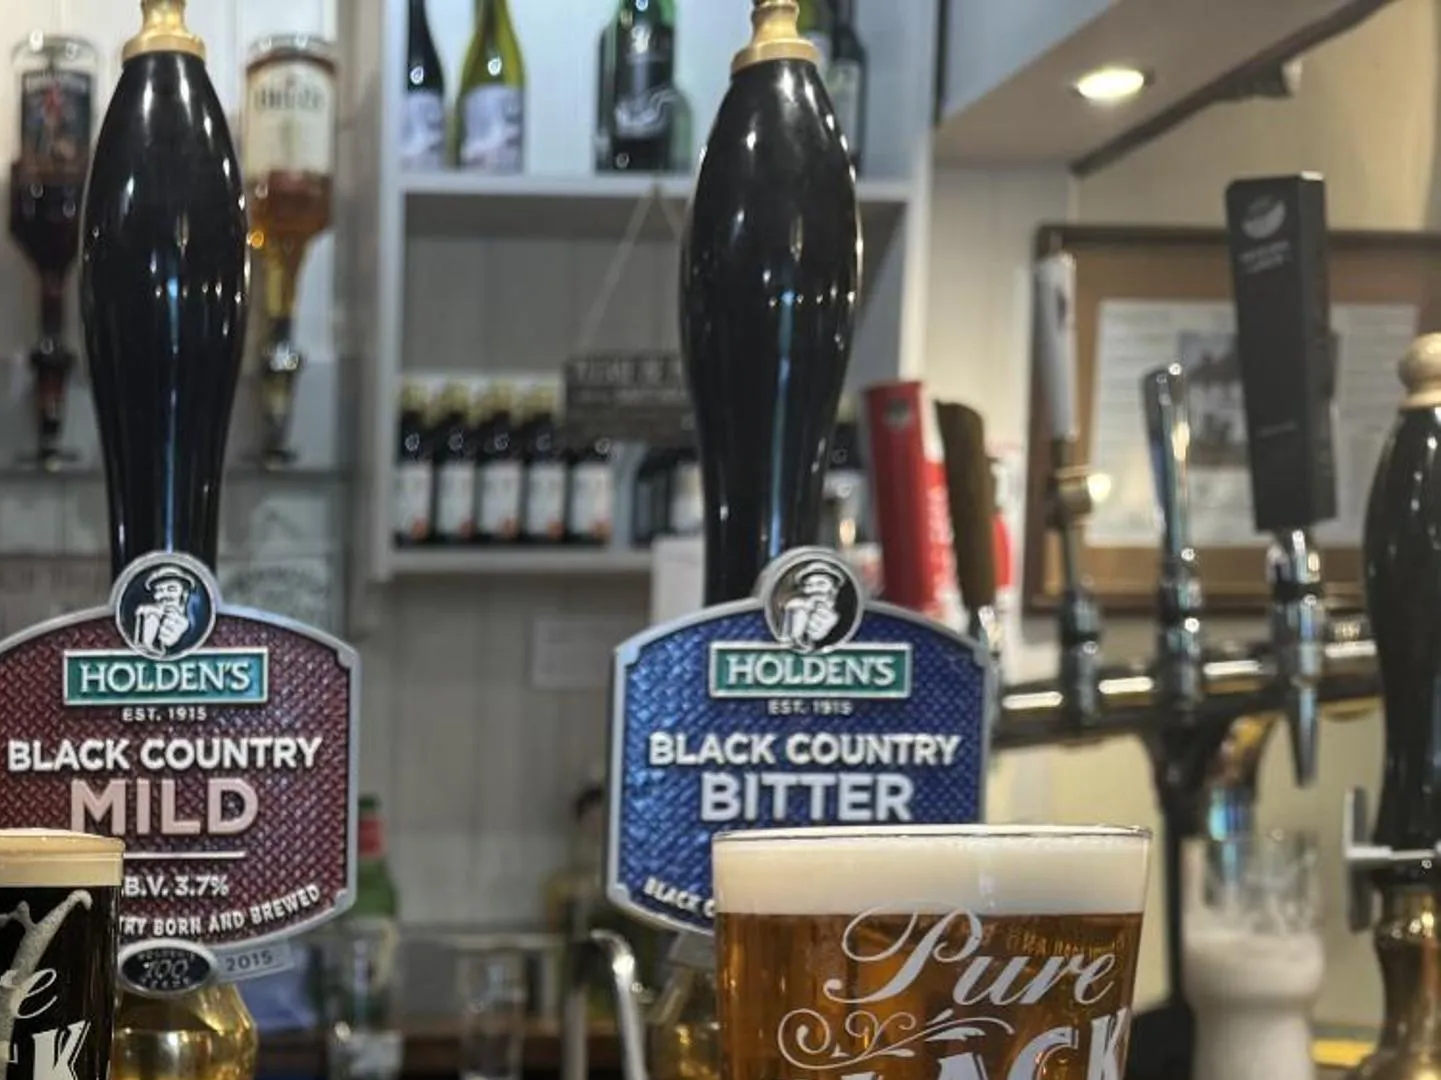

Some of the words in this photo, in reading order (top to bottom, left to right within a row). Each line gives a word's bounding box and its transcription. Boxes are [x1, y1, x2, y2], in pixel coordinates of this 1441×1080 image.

[80, 661, 251, 693] HOLDEN'S
[727, 655, 896, 688] HOLDEN'S
[123, 707, 161, 722] EST.
[169, 707, 206, 722] 1915
[768, 700, 805, 714] EST.
[813, 700, 852, 714] 1915
[8, 739, 130, 772] BLACK
[140, 737, 323, 769] COUNTRY
[649, 734, 776, 766] BLACK
[786, 733, 962, 766] COUNTRY
[70, 778, 259, 836] MILD
[701, 772, 914, 822] BITTER
[121, 875, 168, 897] .B.V.
[174, 874, 229, 897] 3.7%
[644, 877, 700, 909] BLACK
[153, 917, 201, 936] BORN
[208, 911, 245, 932] AND
[251, 884, 321, 924] BREWED
[226, 950, 273, 972] 2015
[824, 901, 1116, 1006] Pure
